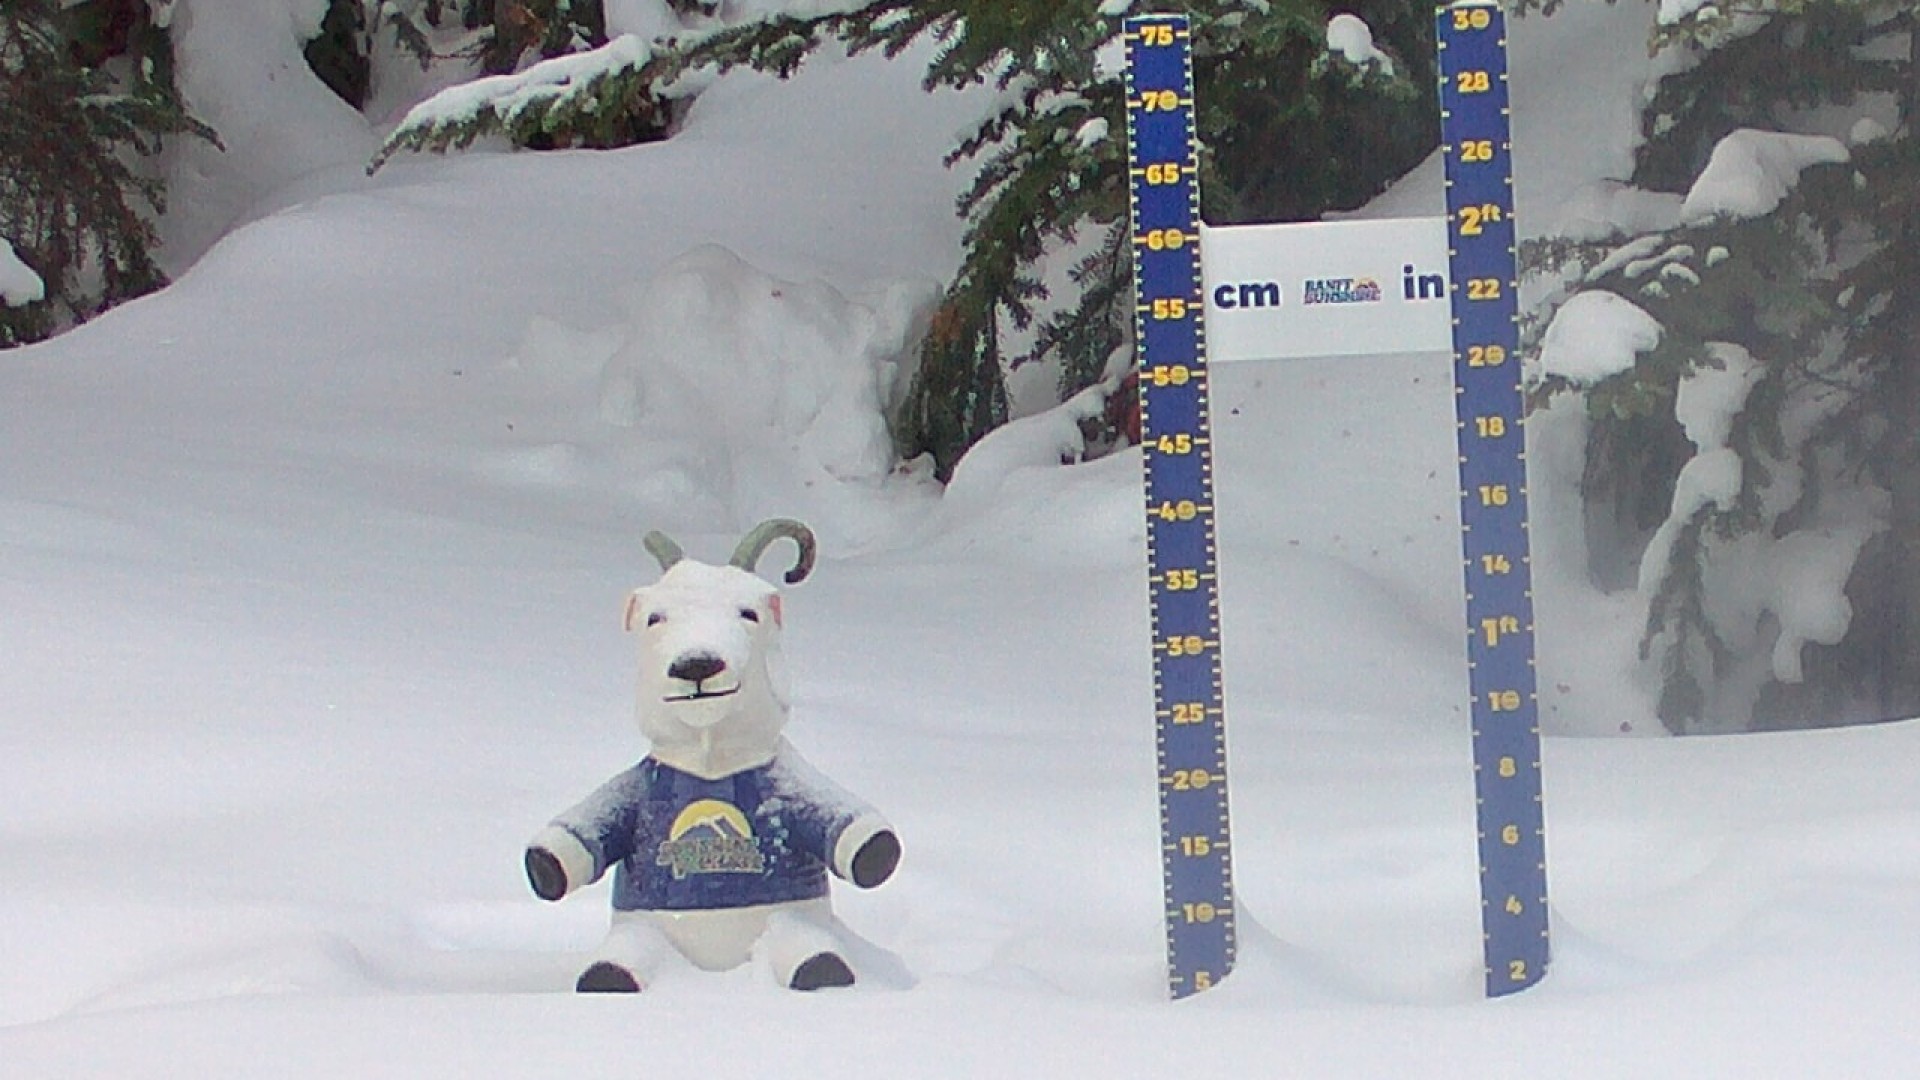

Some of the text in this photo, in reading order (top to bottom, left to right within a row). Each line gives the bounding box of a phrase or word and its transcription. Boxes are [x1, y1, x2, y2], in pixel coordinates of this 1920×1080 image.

[1454, 9, 1489, 29] 30
[1140, 25, 1173, 45] 75
[1458, 71, 1489, 92] 28
[1142, 90, 1178, 110] 70
[1461, 141, 1492, 161] 26
[1146, 163, 1179, 184] 65
[1147, 229, 1183, 250] 60
[1404, 264, 1444, 300] in
[1468, 279, 1499, 299] 22
[1214, 281, 1280, 309] cm
[1153, 298, 1185, 319] 55
[1469, 346, 1504, 366] 20
[1153, 365, 1189, 386] 50
[1477, 416, 1504, 436] 18
[1156, 434, 1191, 454] 45
[1481, 486, 1507, 504] 16
[1159, 501, 1197, 520] 40
[1483, 555, 1510, 574] 14
[1166, 570, 1198, 590] 35
[1167, 636, 1205, 655] 30
[1489, 691, 1519, 709] 10
[1173, 703, 1206, 724] 25
[1500, 758, 1514, 776] 8
[1172, 770, 1211, 790] 20
[1503, 826, 1518, 844] 6
[1182, 836, 1209, 855] 15
[1183, 904, 1216, 922] 10
[1506, 897, 1521, 913] 4
[1510, 962, 1525, 979] 2
[1195, 972, 1211, 991] 5
